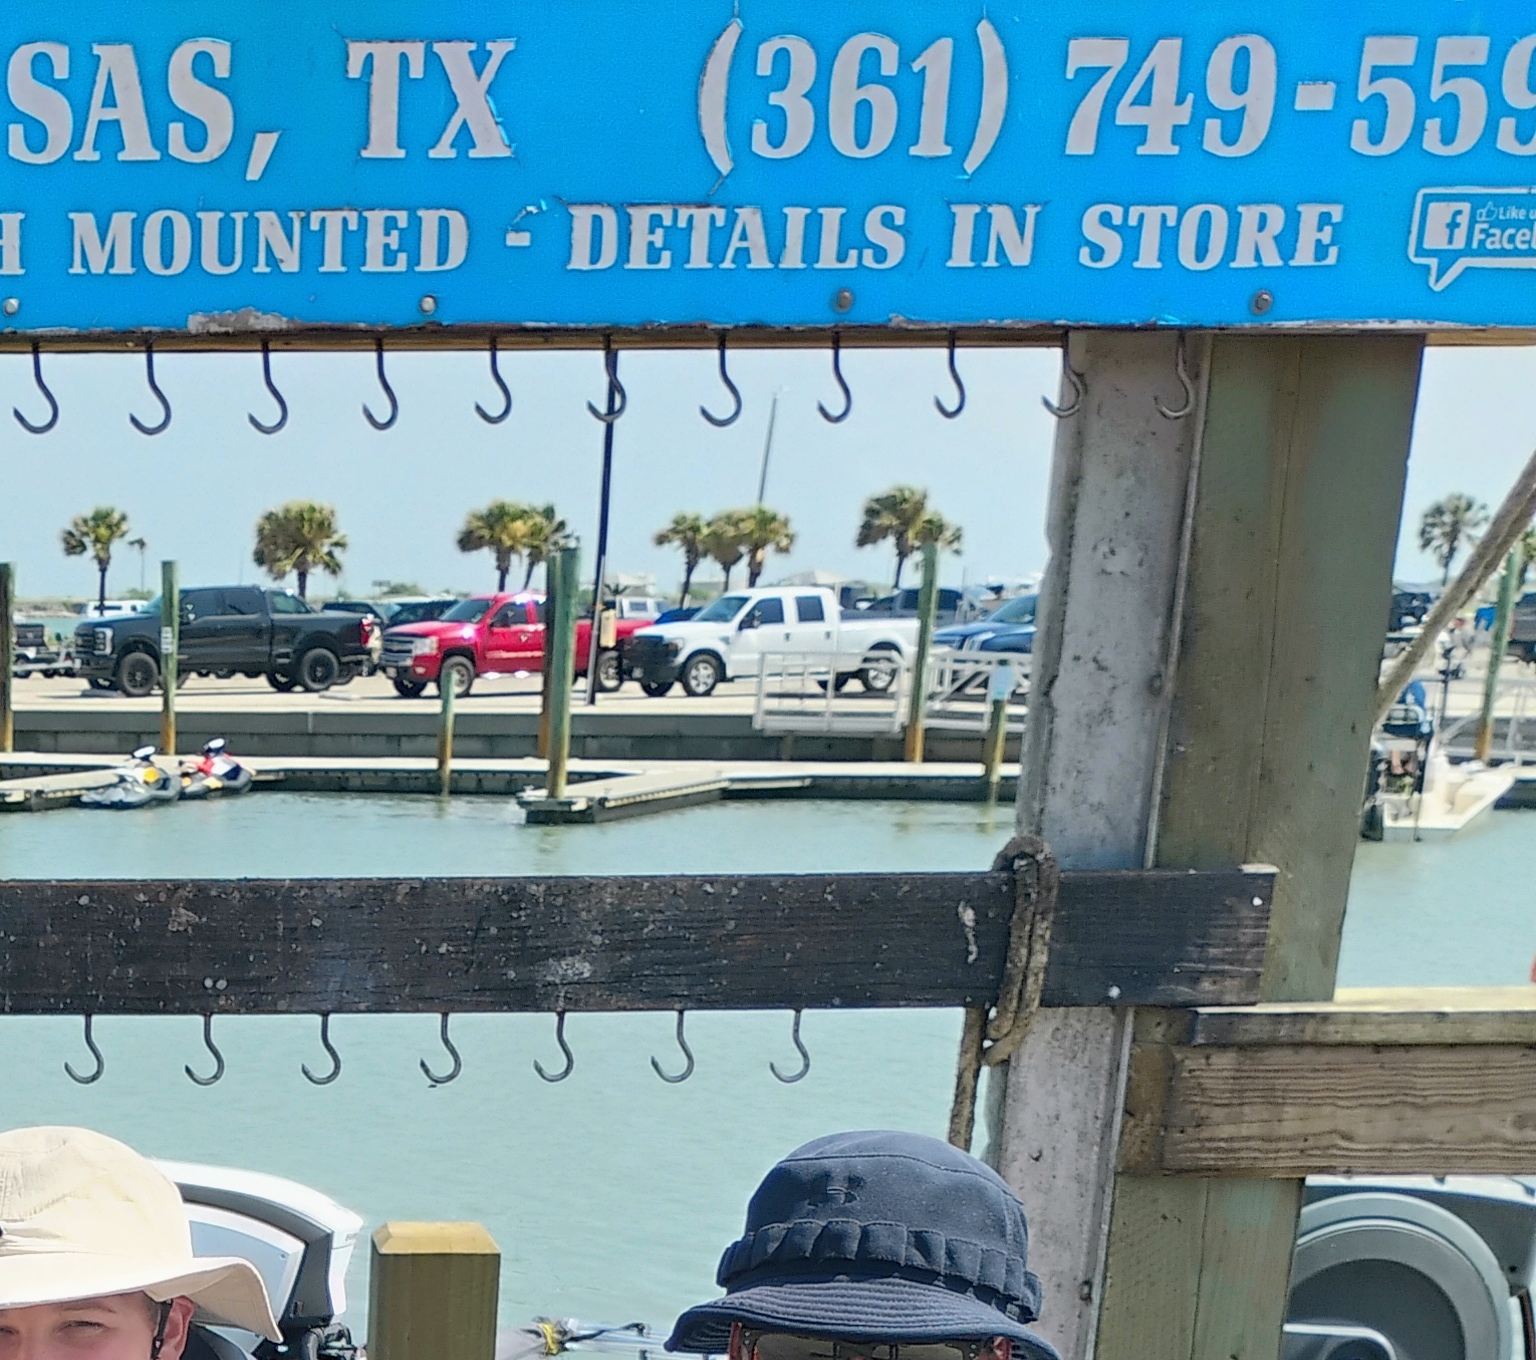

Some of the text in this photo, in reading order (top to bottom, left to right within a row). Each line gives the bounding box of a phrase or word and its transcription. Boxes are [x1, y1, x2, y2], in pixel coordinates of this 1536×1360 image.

[346, 37, 516, 158] TX
[698, 19, 1008, 176] (361)
[69, 208, 469, 275] MOUNTED
[566, 204, 907, 270] DETAILS
[945, 203, 1041, 267] IN
[1079, 202, 1344, 270] STORE
[1498, 206, 1527, 220] Like
